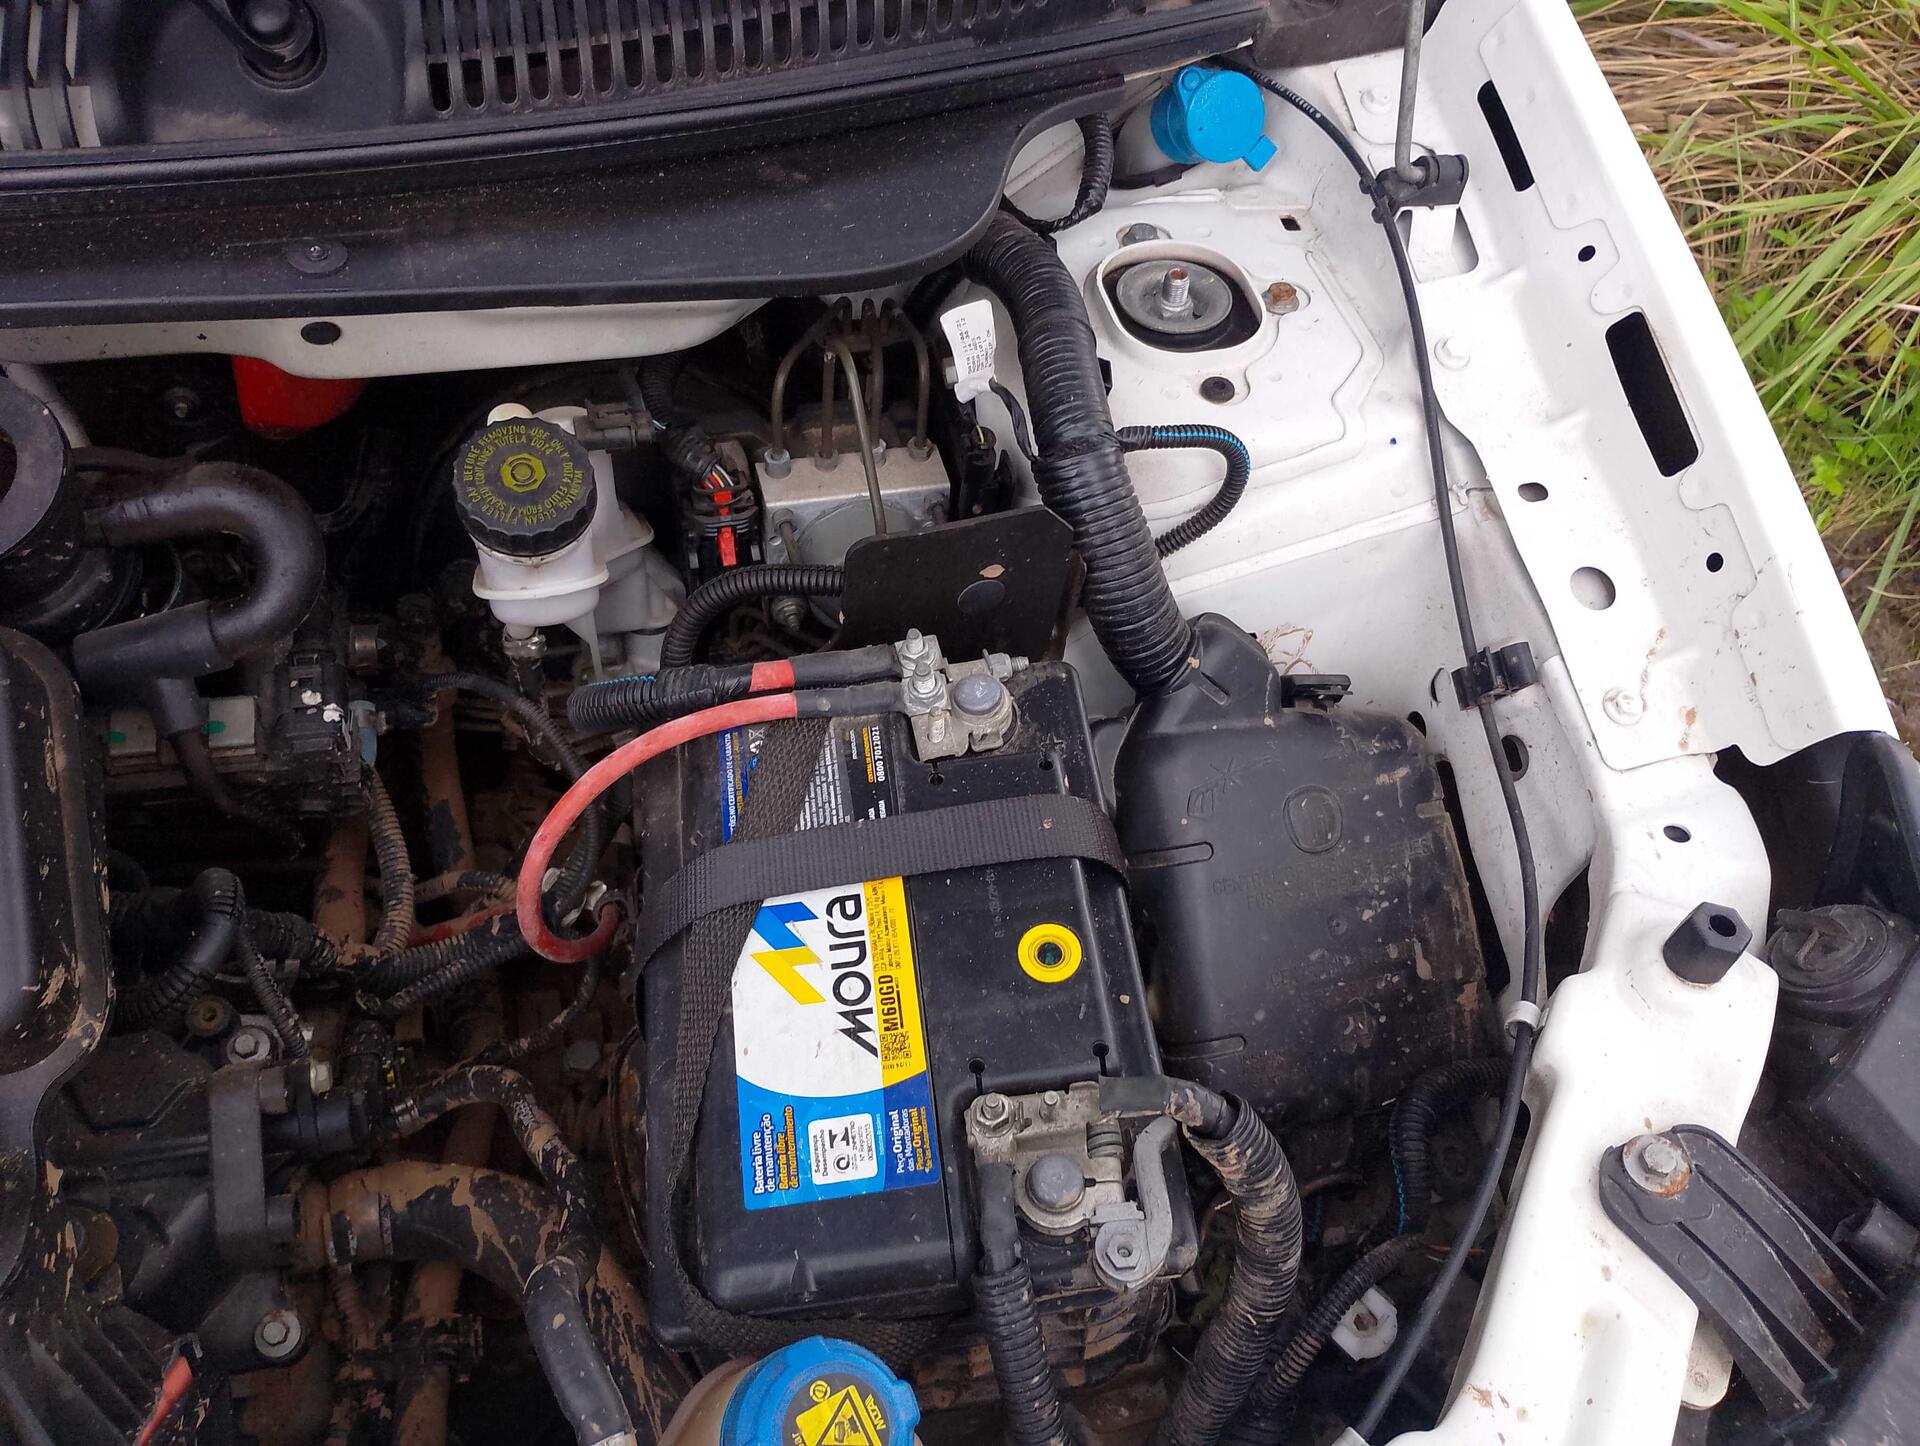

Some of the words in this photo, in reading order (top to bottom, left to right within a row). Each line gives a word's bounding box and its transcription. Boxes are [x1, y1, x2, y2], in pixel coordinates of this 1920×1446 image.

[478, 425, 526, 447] REMOVING
[530, 426, 550, 440] USE
[463, 444, 481, 481] BEFORE
[543, 486, 568, 509] FLUID
[525, 508, 557, 527] CLEAN
[871, 725, 884, 761] 7012021
[875, 761, 886, 782] 0800
[877, 974, 900, 1032] M60GD
[752, 1131, 763, 1155] livre
[761, 1113, 775, 1177] manutenção
[775, 1132, 786, 1154] libre
[784, 1106, 798, 1175] mantenimiento
[888, 1109, 904, 1153] Original
[902, 1108, 913, 1157] Montadoras
[908, 1107, 923, 1148] Original
[812, 1134, 821, 1174] Segurança
[820, 1128, 829, 1177] Desempenho
[896, 1153, 906, 1174] Peça
[907, 1157, 915, 1172] das
[752, 1155, 765, 1194] Bateria
[765, 1177, 776, 1192] de
[777, 1154, 789, 1190] Bateria
[789, 1175, 799, 1188] de
